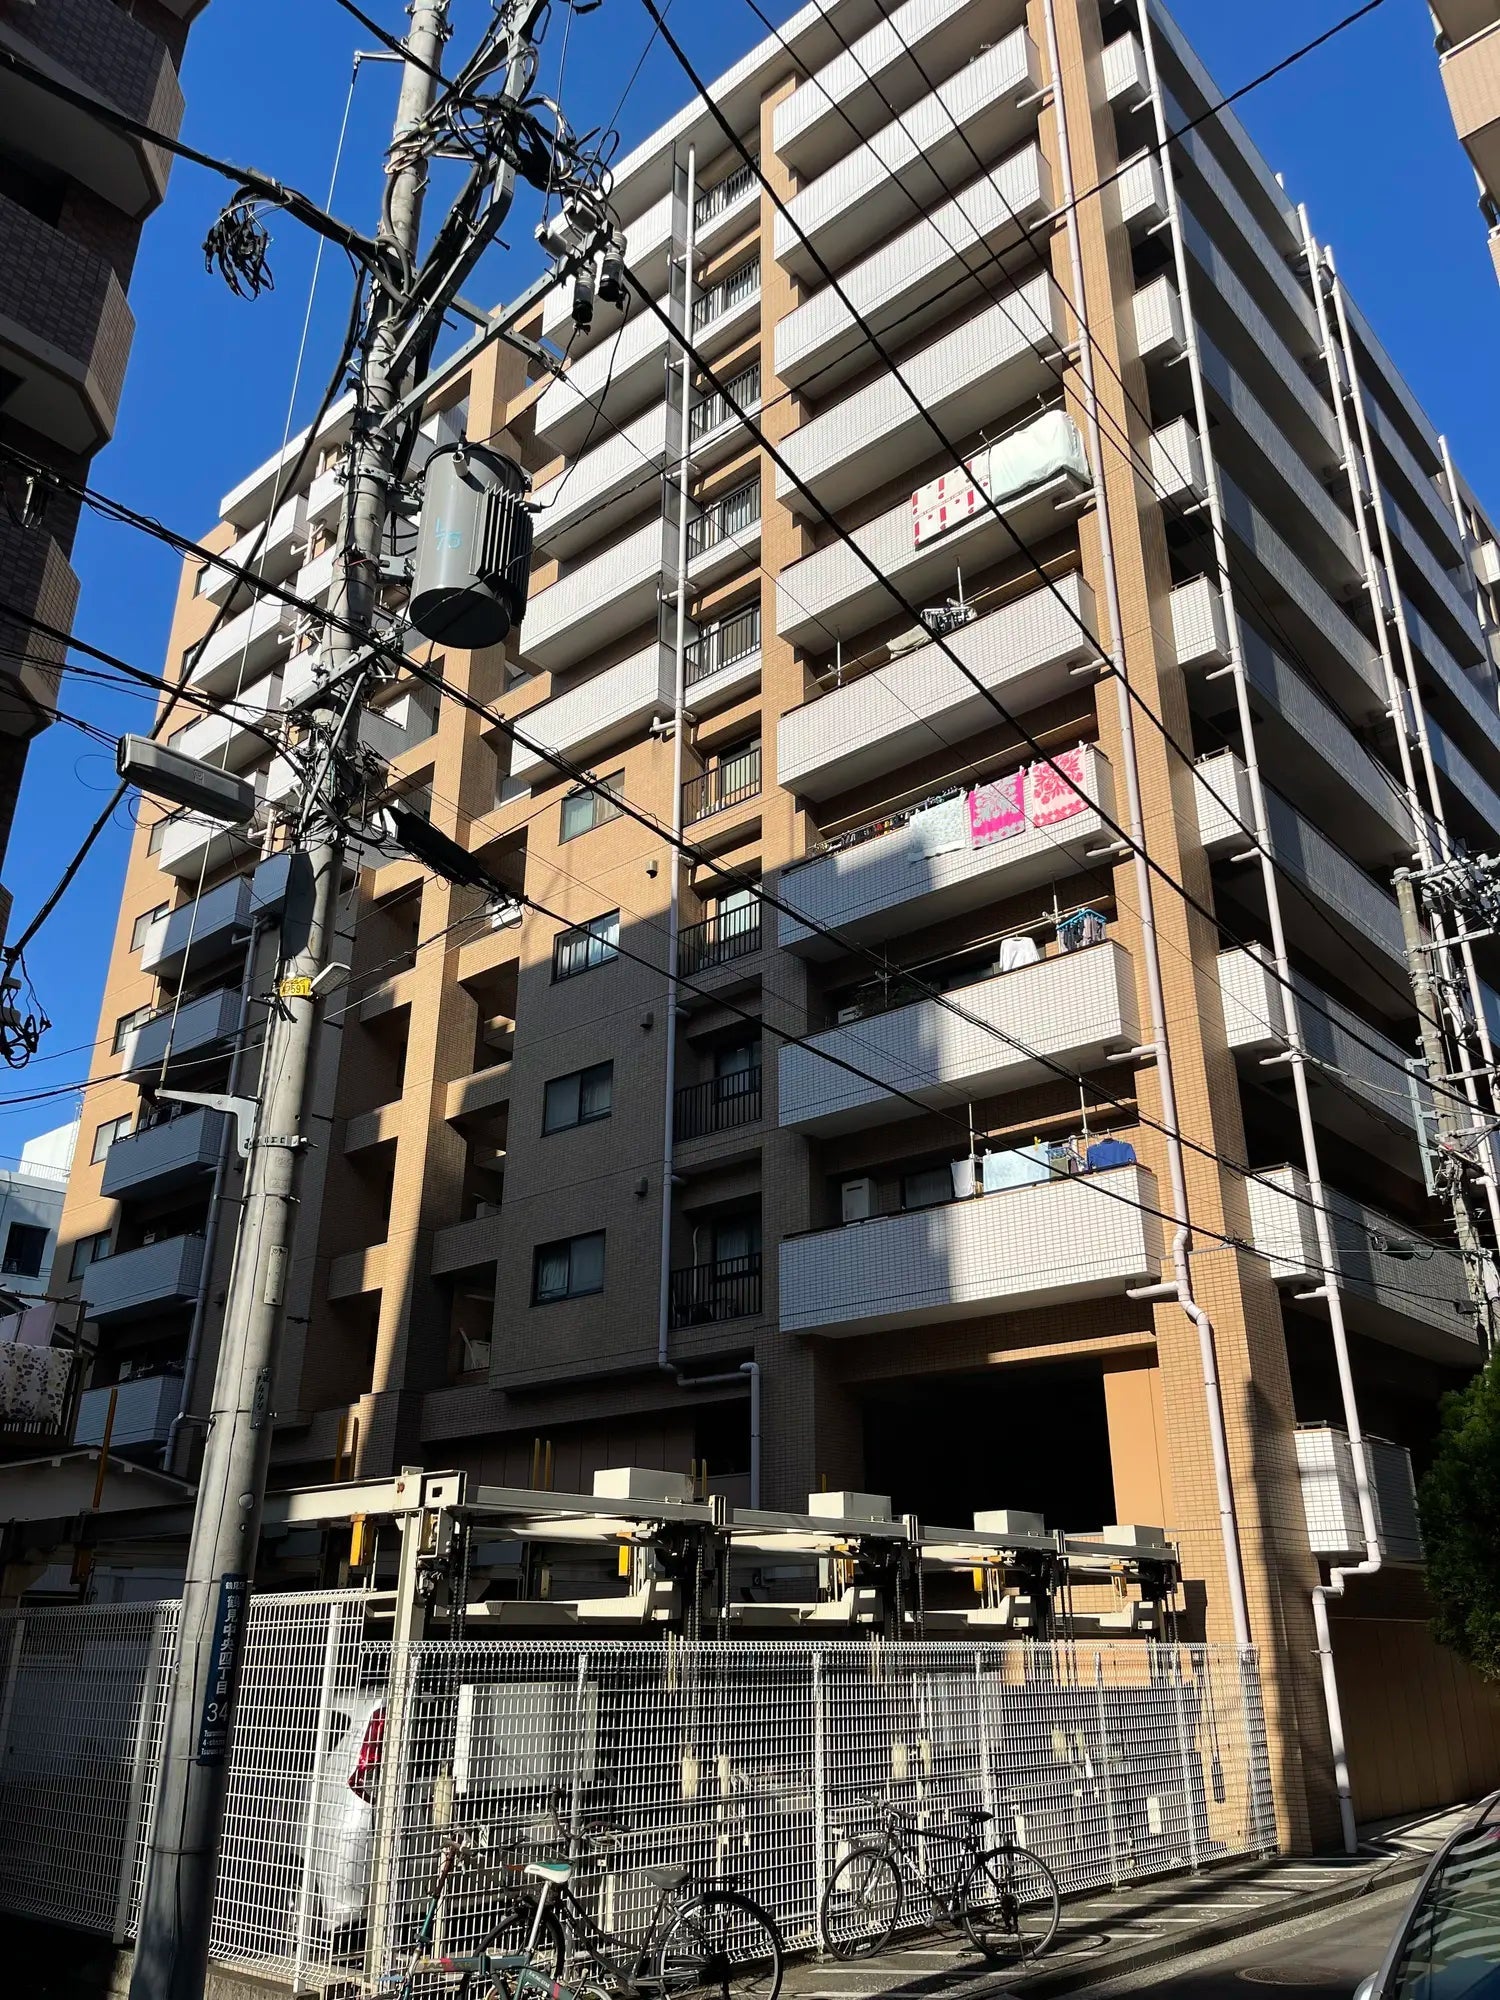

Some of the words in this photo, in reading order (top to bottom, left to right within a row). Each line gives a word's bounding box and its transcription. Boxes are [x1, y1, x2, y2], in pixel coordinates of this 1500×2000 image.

[225, 1581, 246, 1591] 鶴見区
[216, 1594, 241, 1695] 鶴見中央四丁目
[206, 1702, 228, 1722] 34
